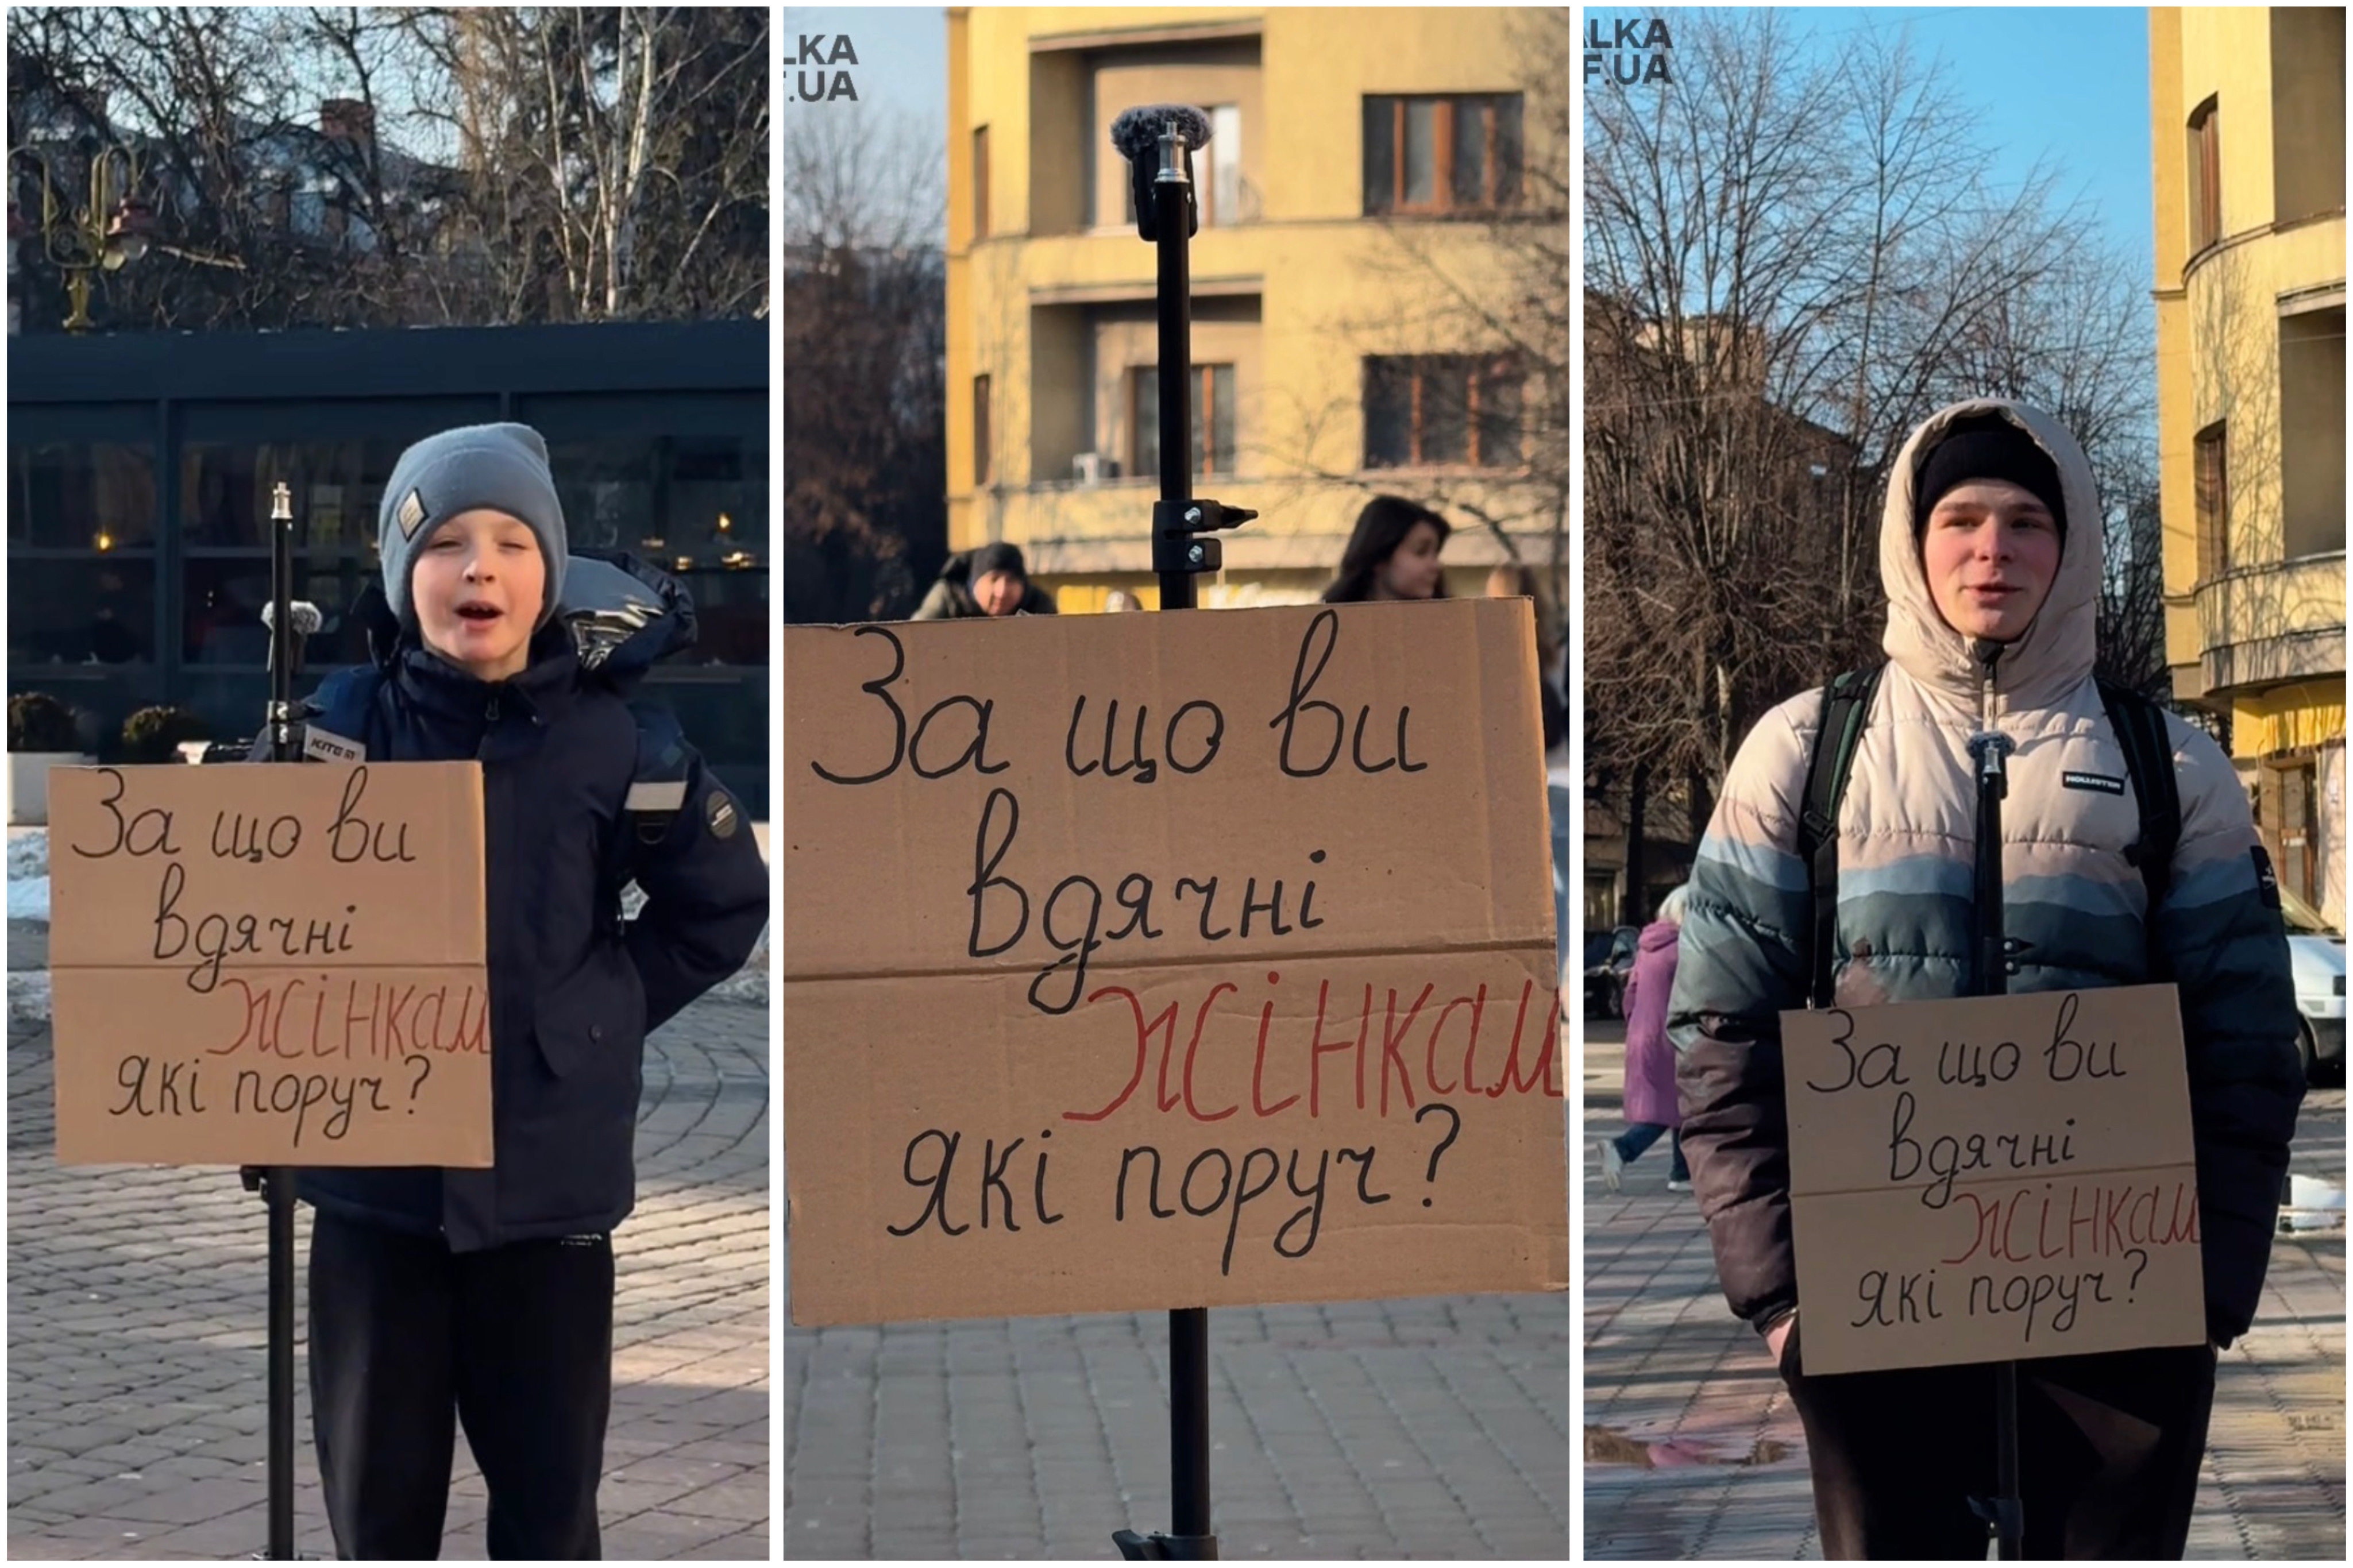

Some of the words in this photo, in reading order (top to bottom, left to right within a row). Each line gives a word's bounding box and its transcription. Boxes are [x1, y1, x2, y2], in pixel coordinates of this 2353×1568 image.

[811, 626, 1011, 785] За
[1066, 694, 1225, 784] що
[1268, 608, 1428, 778] ви
[71, 767, 182, 858] За
[211, 810, 302, 864] що
[326, 765, 416, 863] ви
[153, 862, 357, 994] вдячні
[967, 787, 1327, 1015] вдячні
[234, 1053, 431, 1148] поруч?
[1806, 1008, 1910, 1093] За
[1938, 1041, 2021, 1088] що
[2043, 993, 2127, 1082] ви
[1116, 1103, 1461, 1277] поруч?
[1889, 1091, 2076, 1209] вдячні
[1969, 1248, 2148, 1343] поруч?
